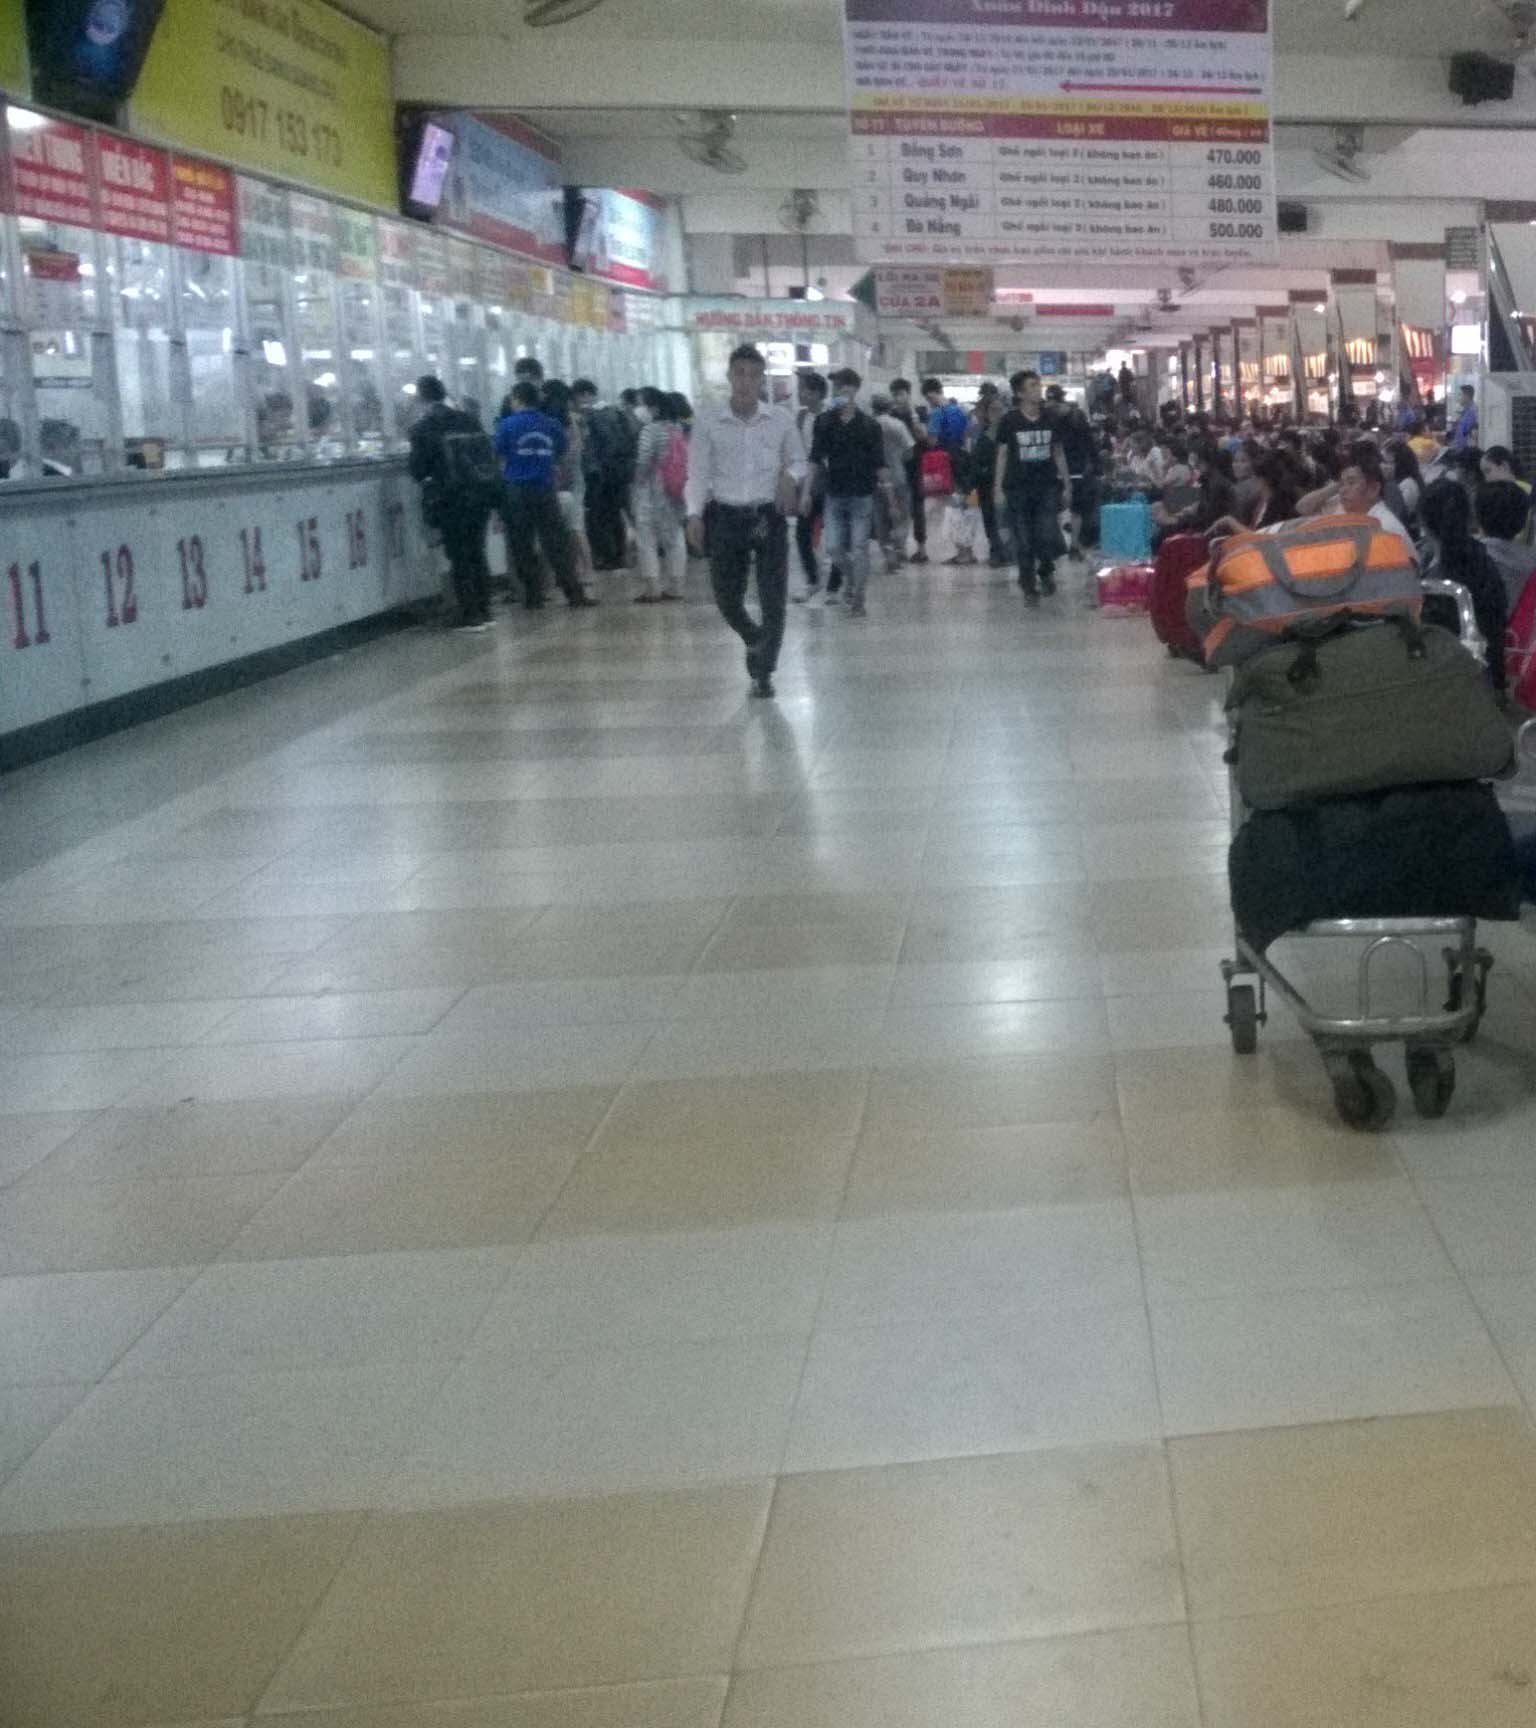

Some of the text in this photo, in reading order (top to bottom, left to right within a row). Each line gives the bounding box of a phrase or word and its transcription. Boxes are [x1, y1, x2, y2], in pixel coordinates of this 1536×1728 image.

[1128, 2, 1175, 17] 2017
[1206, 149, 1262, 165] 470.000
[1208, 173, 1262, 190] 460.000
[1208, 198, 1262, 214] 480.000
[1209, 222, 1263, 239] 500.000
[239, 525, 266, 594] 14
[297, 515, 322, 582] 15
[101, 543, 138, 628] 12
[176, 533, 208, 610] 13
[7, 560, 50, 649] 11
